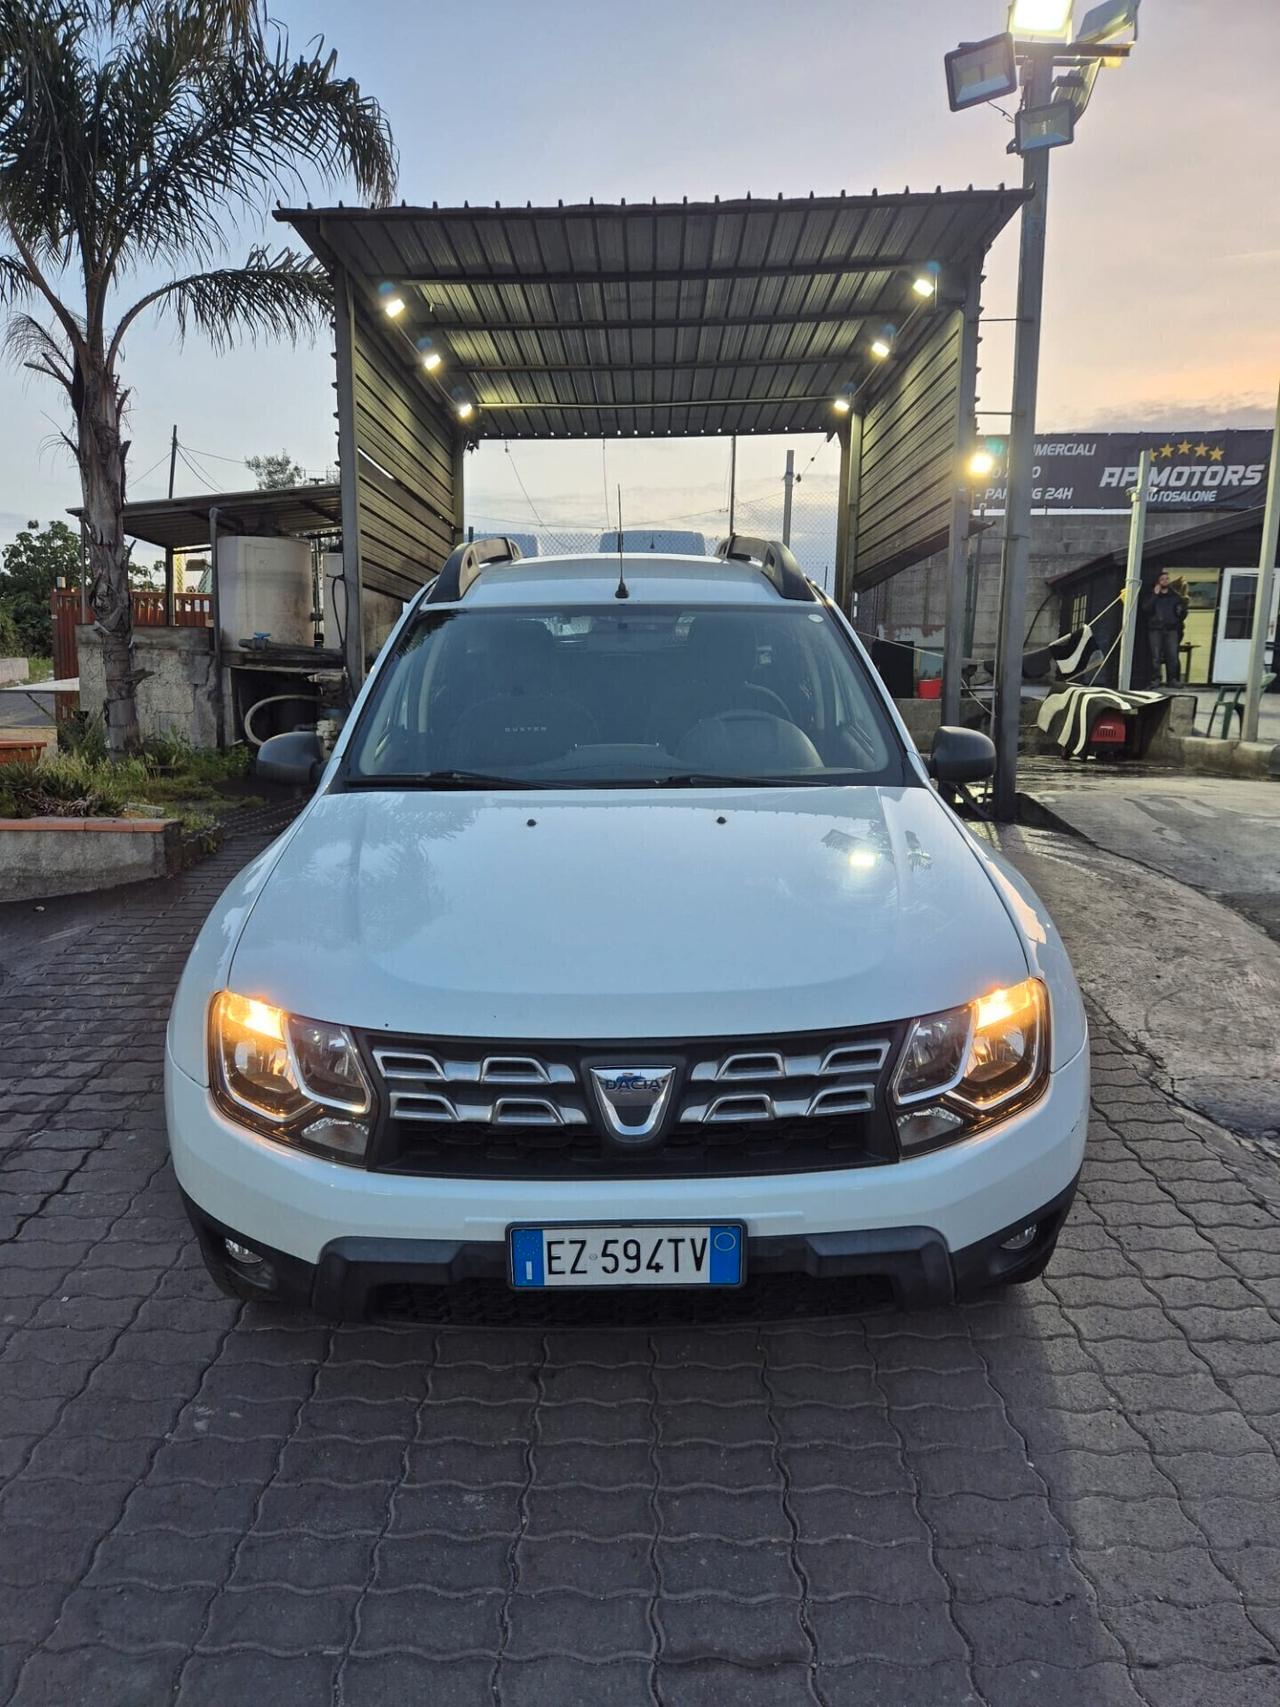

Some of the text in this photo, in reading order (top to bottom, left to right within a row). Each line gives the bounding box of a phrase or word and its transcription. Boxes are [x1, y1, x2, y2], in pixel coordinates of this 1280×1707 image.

[1033, 443, 1097, 456] MERCIALI
[1148, 464, 1265, 487] MOTORS
[1045, 487, 1073, 500] 24H
[605, 1079, 661, 1091] DACIA
